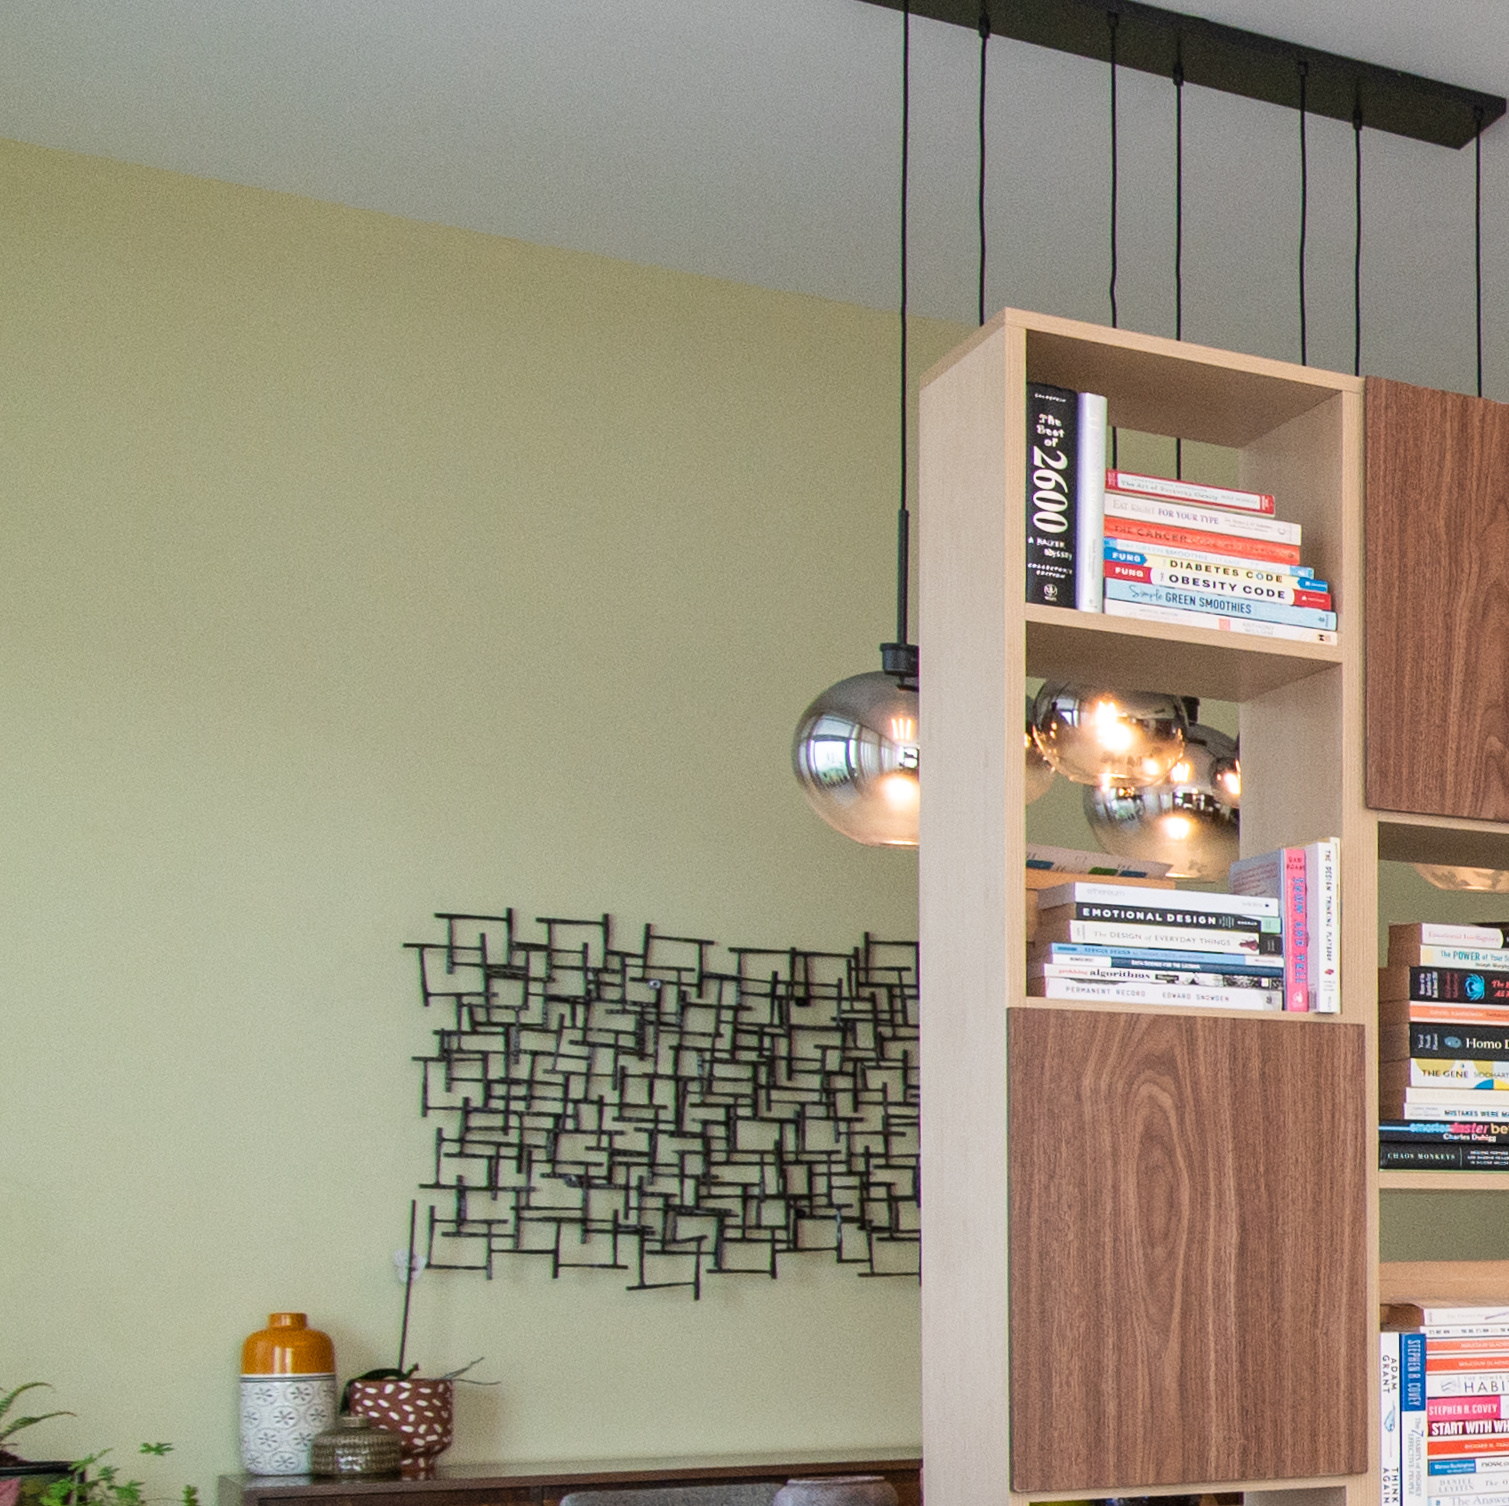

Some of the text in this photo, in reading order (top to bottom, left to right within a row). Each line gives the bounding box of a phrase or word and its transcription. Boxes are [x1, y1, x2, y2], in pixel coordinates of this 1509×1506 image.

[1038, 414, 1062, 427] The
[1036, 425, 1065, 438] Best
[1044, 438, 1059, 447] of
[1032, 446, 1069, 533] 2600
[1158, 508, 1174, 518] FOR
[1176, 511, 1199, 522] YOUR
[1200, 514, 1220, 525] TYPE
[1137, 528, 1187, 542] CANCER
[1112, 552, 1142, 563] FUNG
[1115, 567, 1145, 578] FUNG
[1169, 559, 1284, 583] DIABETES CODE
[1168, 574, 1286, 600] OBESITY CODE
[1129, 585, 1164, 602] Simple
[1165, 591, 1197, 606] GREEN
[1198, 596, 1253, 615] SMOOTHIES
[1324, 850, 1332, 862] THE
[1324, 866, 1333, 891] DESIGN
[1081, 907, 1217, 925] EMOTIONAL DESIGN
[1325, 895, 1333, 927] THINKING
[1293, 877, 1306, 984] SHOW AND TELL
[1110, 932, 1142, 941] DESIGN
[1154, 935, 1196, 944] EVERYDAY
[1200, 937, 1232, 947] THINGS
[1441, 950, 1451, 958] The
[1452, 951, 1481, 961] POWER
[1089, 967, 1151, 980] algorithms
[1491, 980, 1505, 988] The
[1065, 986, 1230, 1002] PERMANENT RECORD EDWARD SNOWDEN
[1465, 1037, 1502, 1050] Homo
[1442, 1070, 1469, 1079] GENE
[1450, 1122, 1490, 1134] faster
[1442, 1133, 1497, 1143] Charles Duhigg
[1387, 1152, 1456, 1161] CHAOS MONKEYS
[1382, 1355, 1391, 1394] GRANT
[1407, 1339, 1421, 1406] STEPHEN COVEY
[1429, 1403, 1498, 1416] STEPHEN COVEY
[1431, 1421, 1464, 1436] START
[1464, 1420, 1492, 1434] WITH
[1382, 1467, 1391, 1504] AGAIN
[1391, 1466, 1400, 1503] THINK
[1440, 1477, 1472, 1486] DANIEL
[1484, 1479, 1499, 1487] The
[1438, 1484, 1475, 1493] LEVITIN
[1449, 1497, 1471, 1506] The
